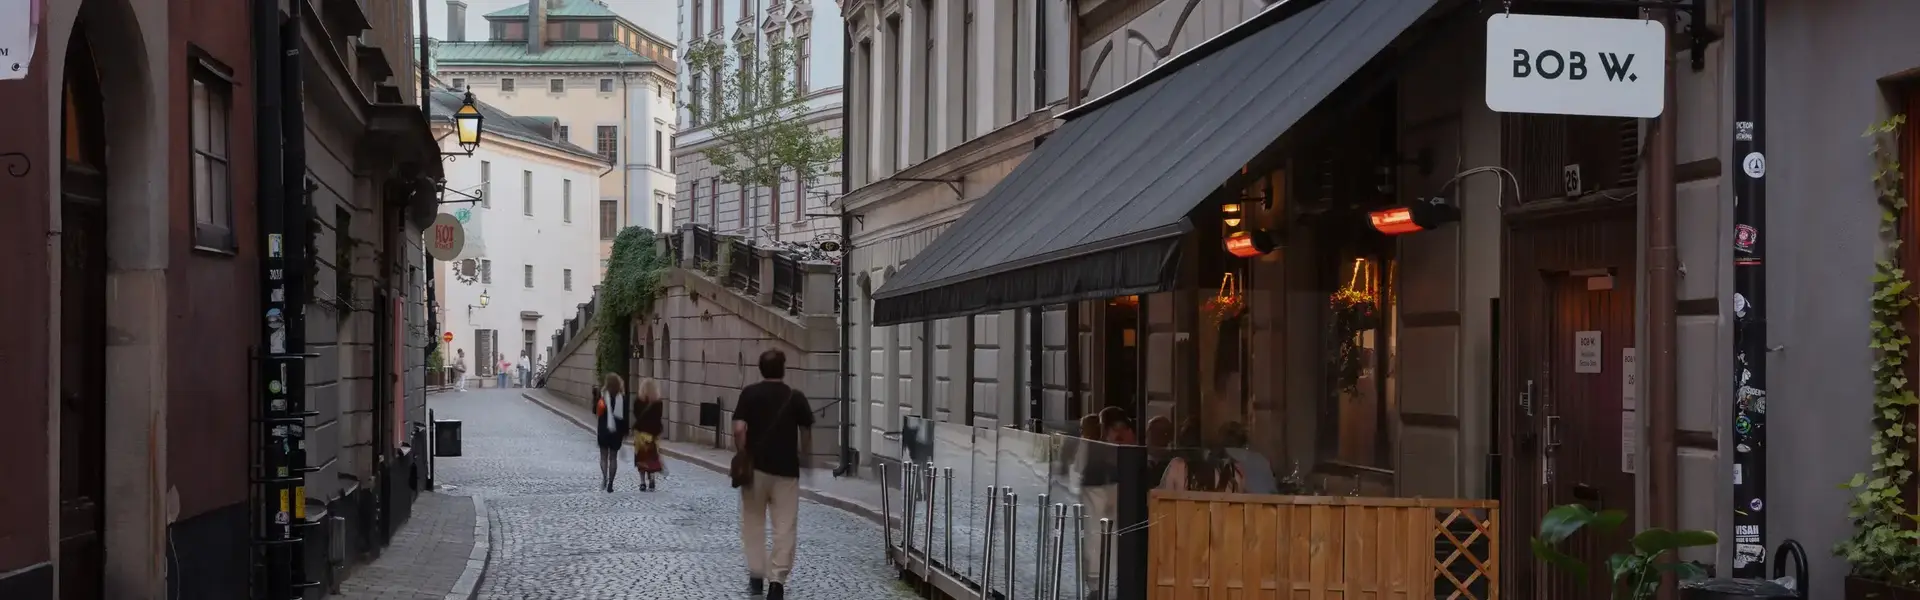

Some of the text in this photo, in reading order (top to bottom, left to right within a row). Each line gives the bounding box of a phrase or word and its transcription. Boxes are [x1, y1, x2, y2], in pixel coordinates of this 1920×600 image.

[1513, 48, 1638, 82] BOB W.
[1566, 169, 1578, 192] 26
